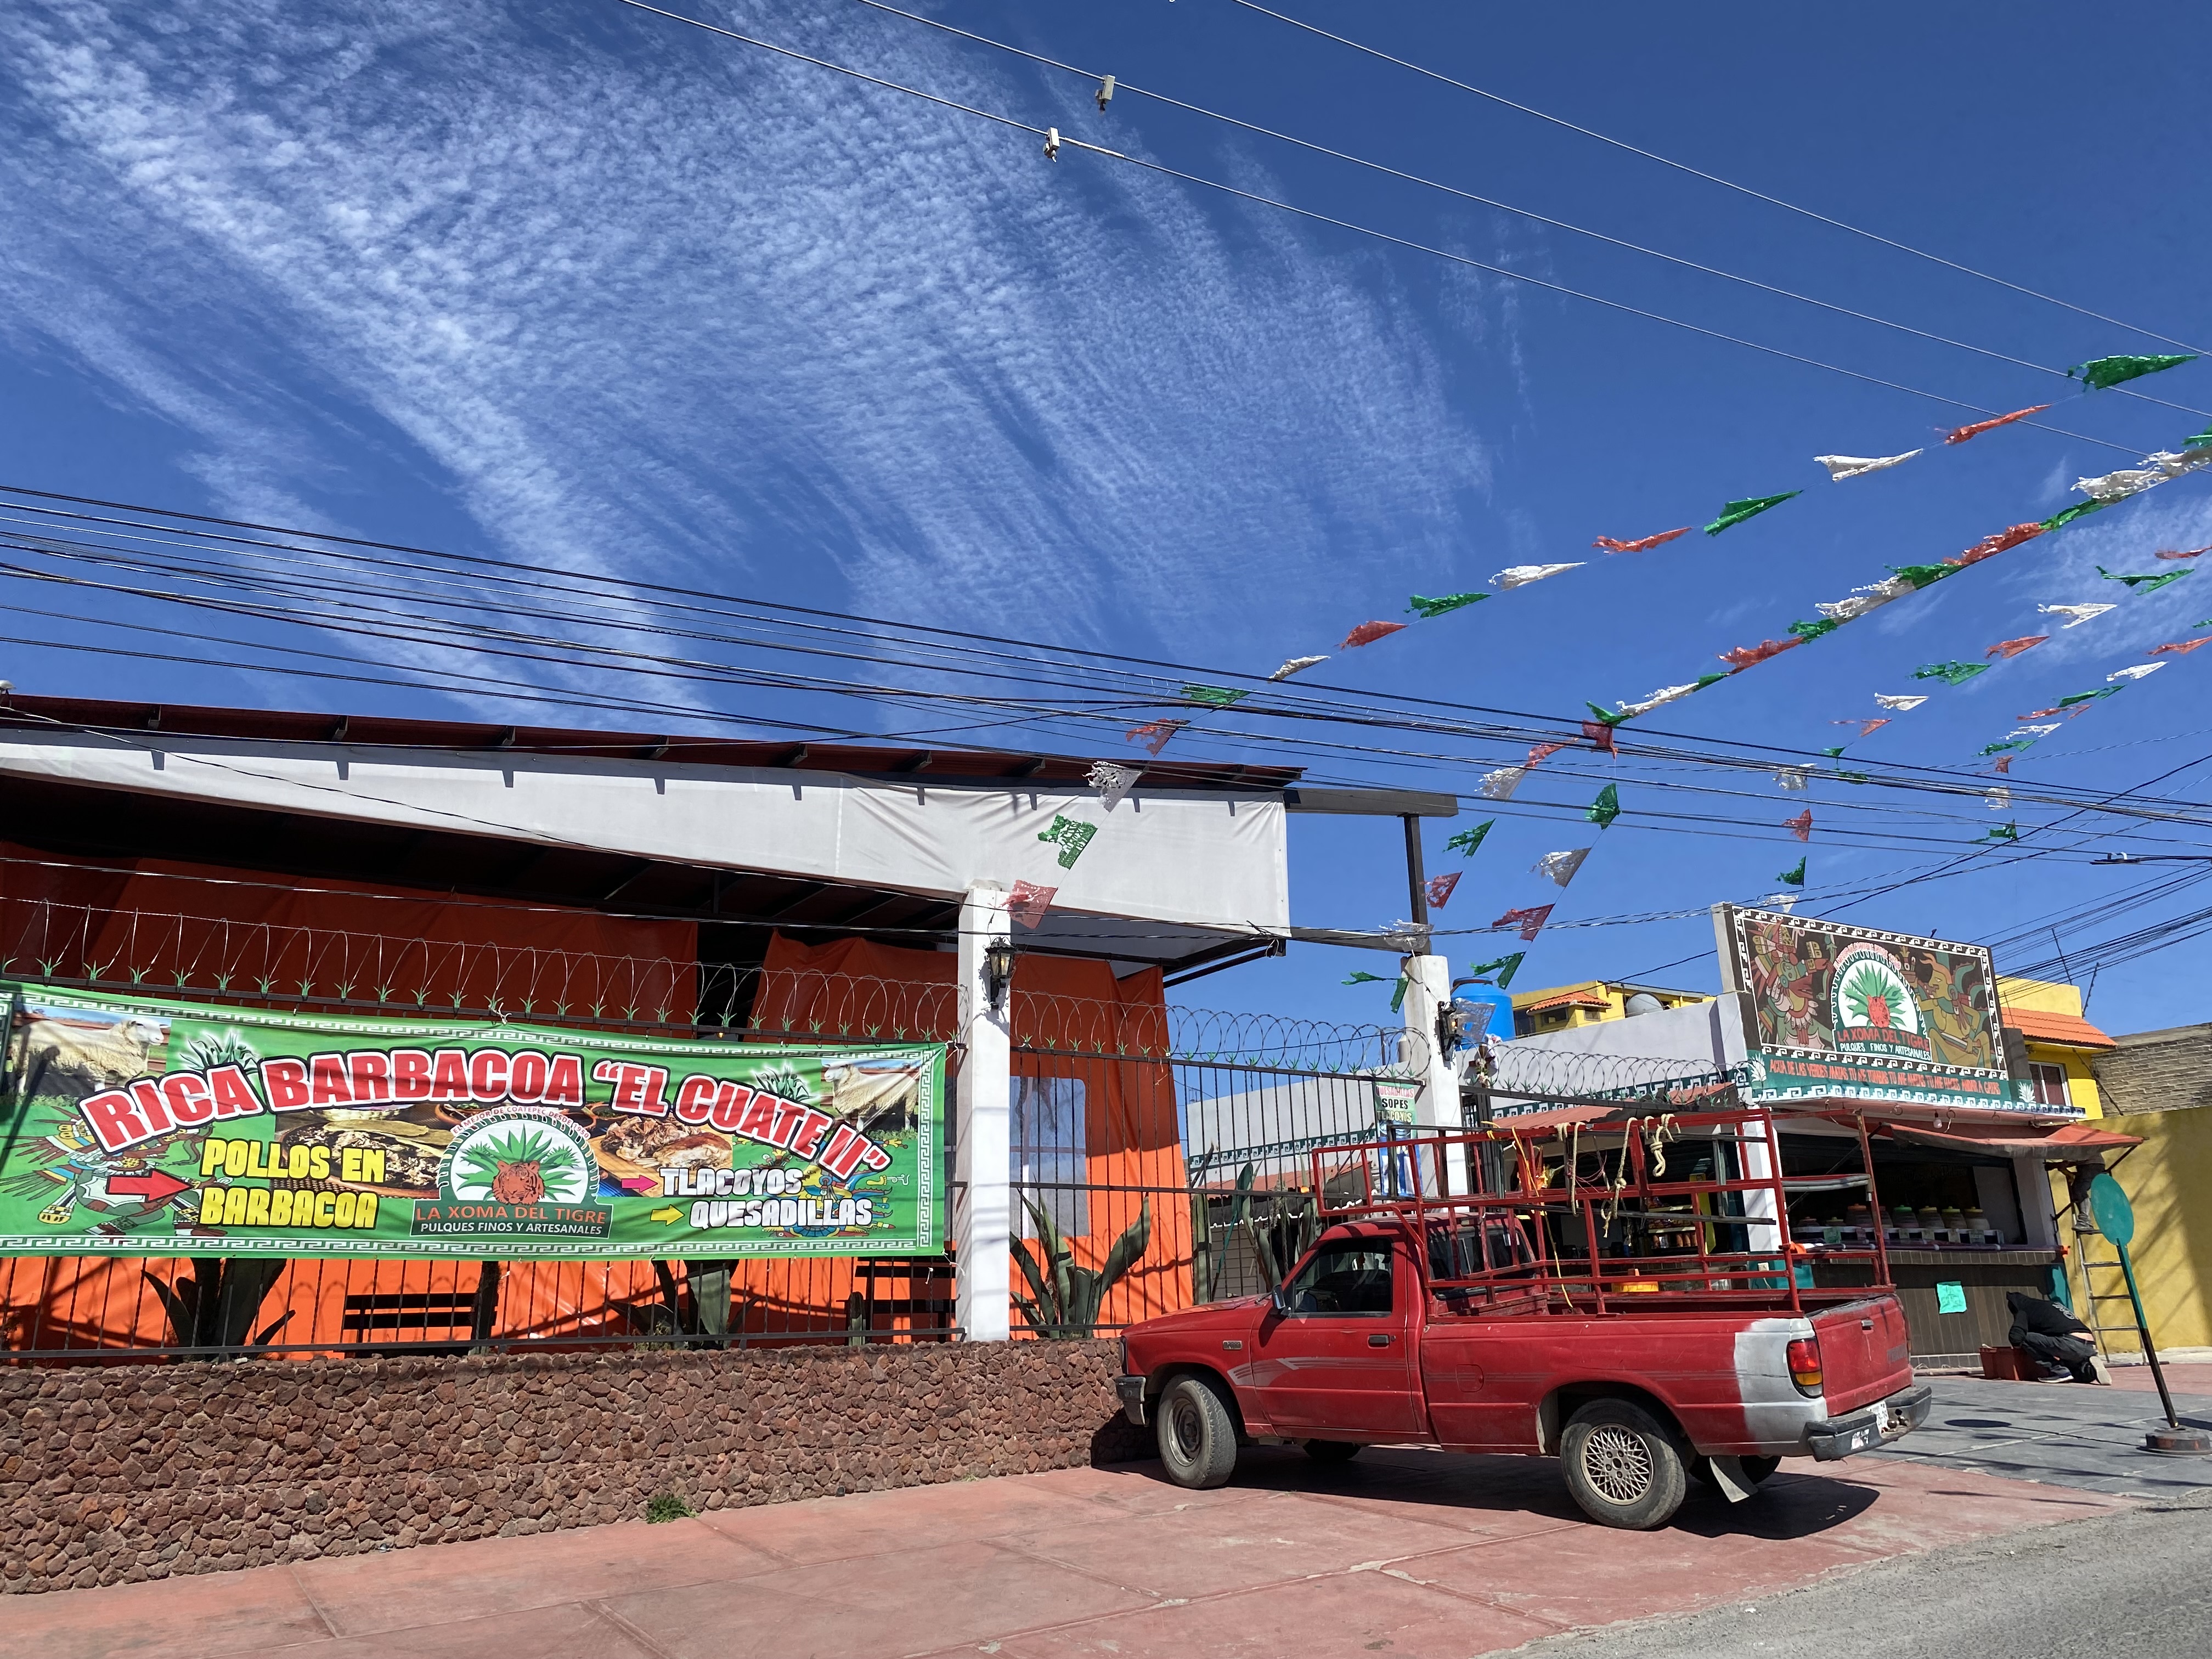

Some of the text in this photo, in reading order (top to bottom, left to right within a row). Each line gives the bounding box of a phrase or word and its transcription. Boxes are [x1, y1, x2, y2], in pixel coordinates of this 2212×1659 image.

[1837, 1028, 1930, 1052] LA XOMA DEL TIGRE
[1840, 1042, 1931, 1061] PULQUES FINOS Y ARTESANALES
[79, 1063, 266, 1153] RICA
[261, 1048, 585, 1114] BARBACOA
[675, 1075, 834, 1161] CUATE
[1376, 1110, 1412, 1122] TLACOYOS
[1381, 1098, 1408, 1109] SOPES
[453, 1125, 462, 1135] EL
[463, 1111, 490, 1127] MEJOR
[506, 1105, 546, 1115] COATEPEC
[549, 1111, 572, 1126] DESDE
[573, 1124, 590, 1139] 1950
[201, 1137, 386, 1183] POLLOS EN
[659, 1167, 803, 1197] TLACOYOS
[199, 1186, 379, 1229] BARBACOA
[416, 1206, 607, 1224] LA XOMA DEL TIGRE
[690, 1198, 873, 1230] QUESADILLAS
[420, 1222, 602, 1235] PULQUES FINOS Y ARTESANALES
